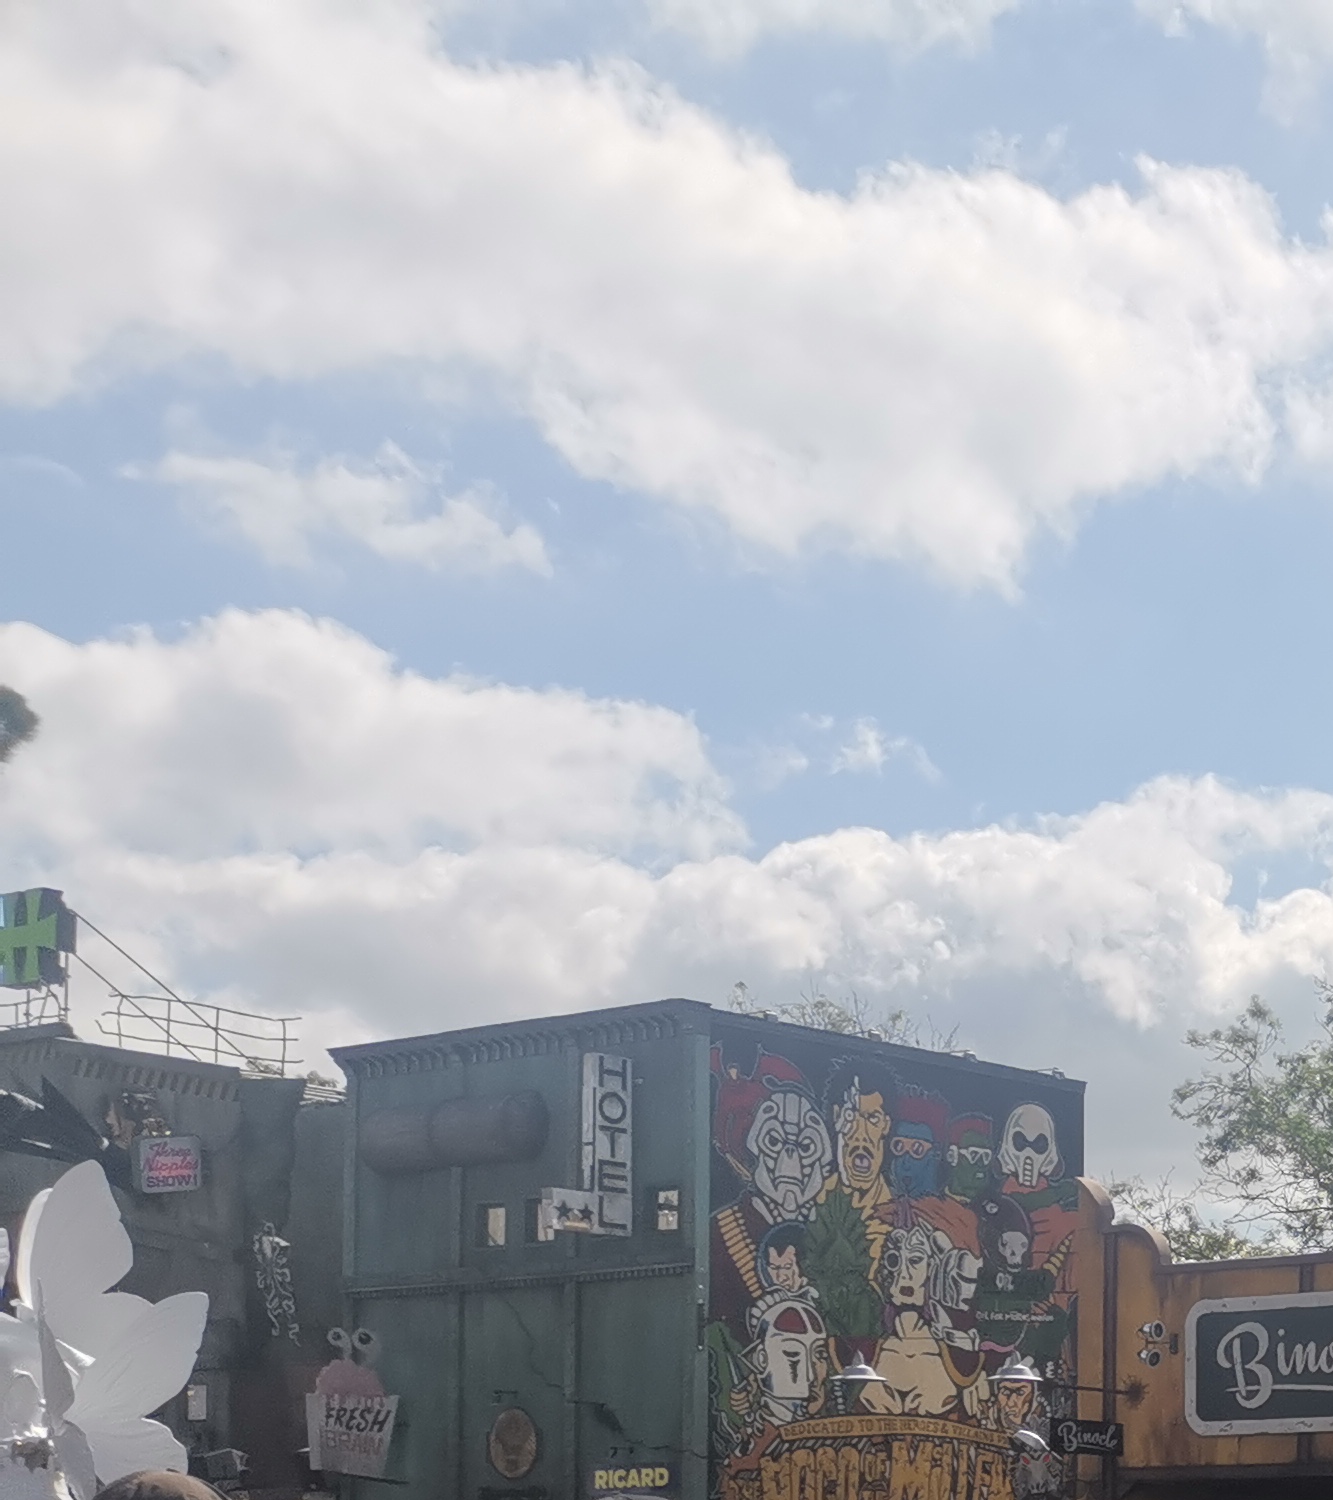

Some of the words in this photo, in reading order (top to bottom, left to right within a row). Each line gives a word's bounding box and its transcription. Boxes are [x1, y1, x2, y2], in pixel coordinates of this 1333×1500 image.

[598, 1055, 629, 1231] HOTEL
[324, 1406, 392, 1433] FRESH
[783, 1419, 854, 1438] DEDICATED
[857, 1418, 874, 1433] TO
[876, 1418, 899, 1432] THE
[594, 1467, 670, 1490] RICARD
